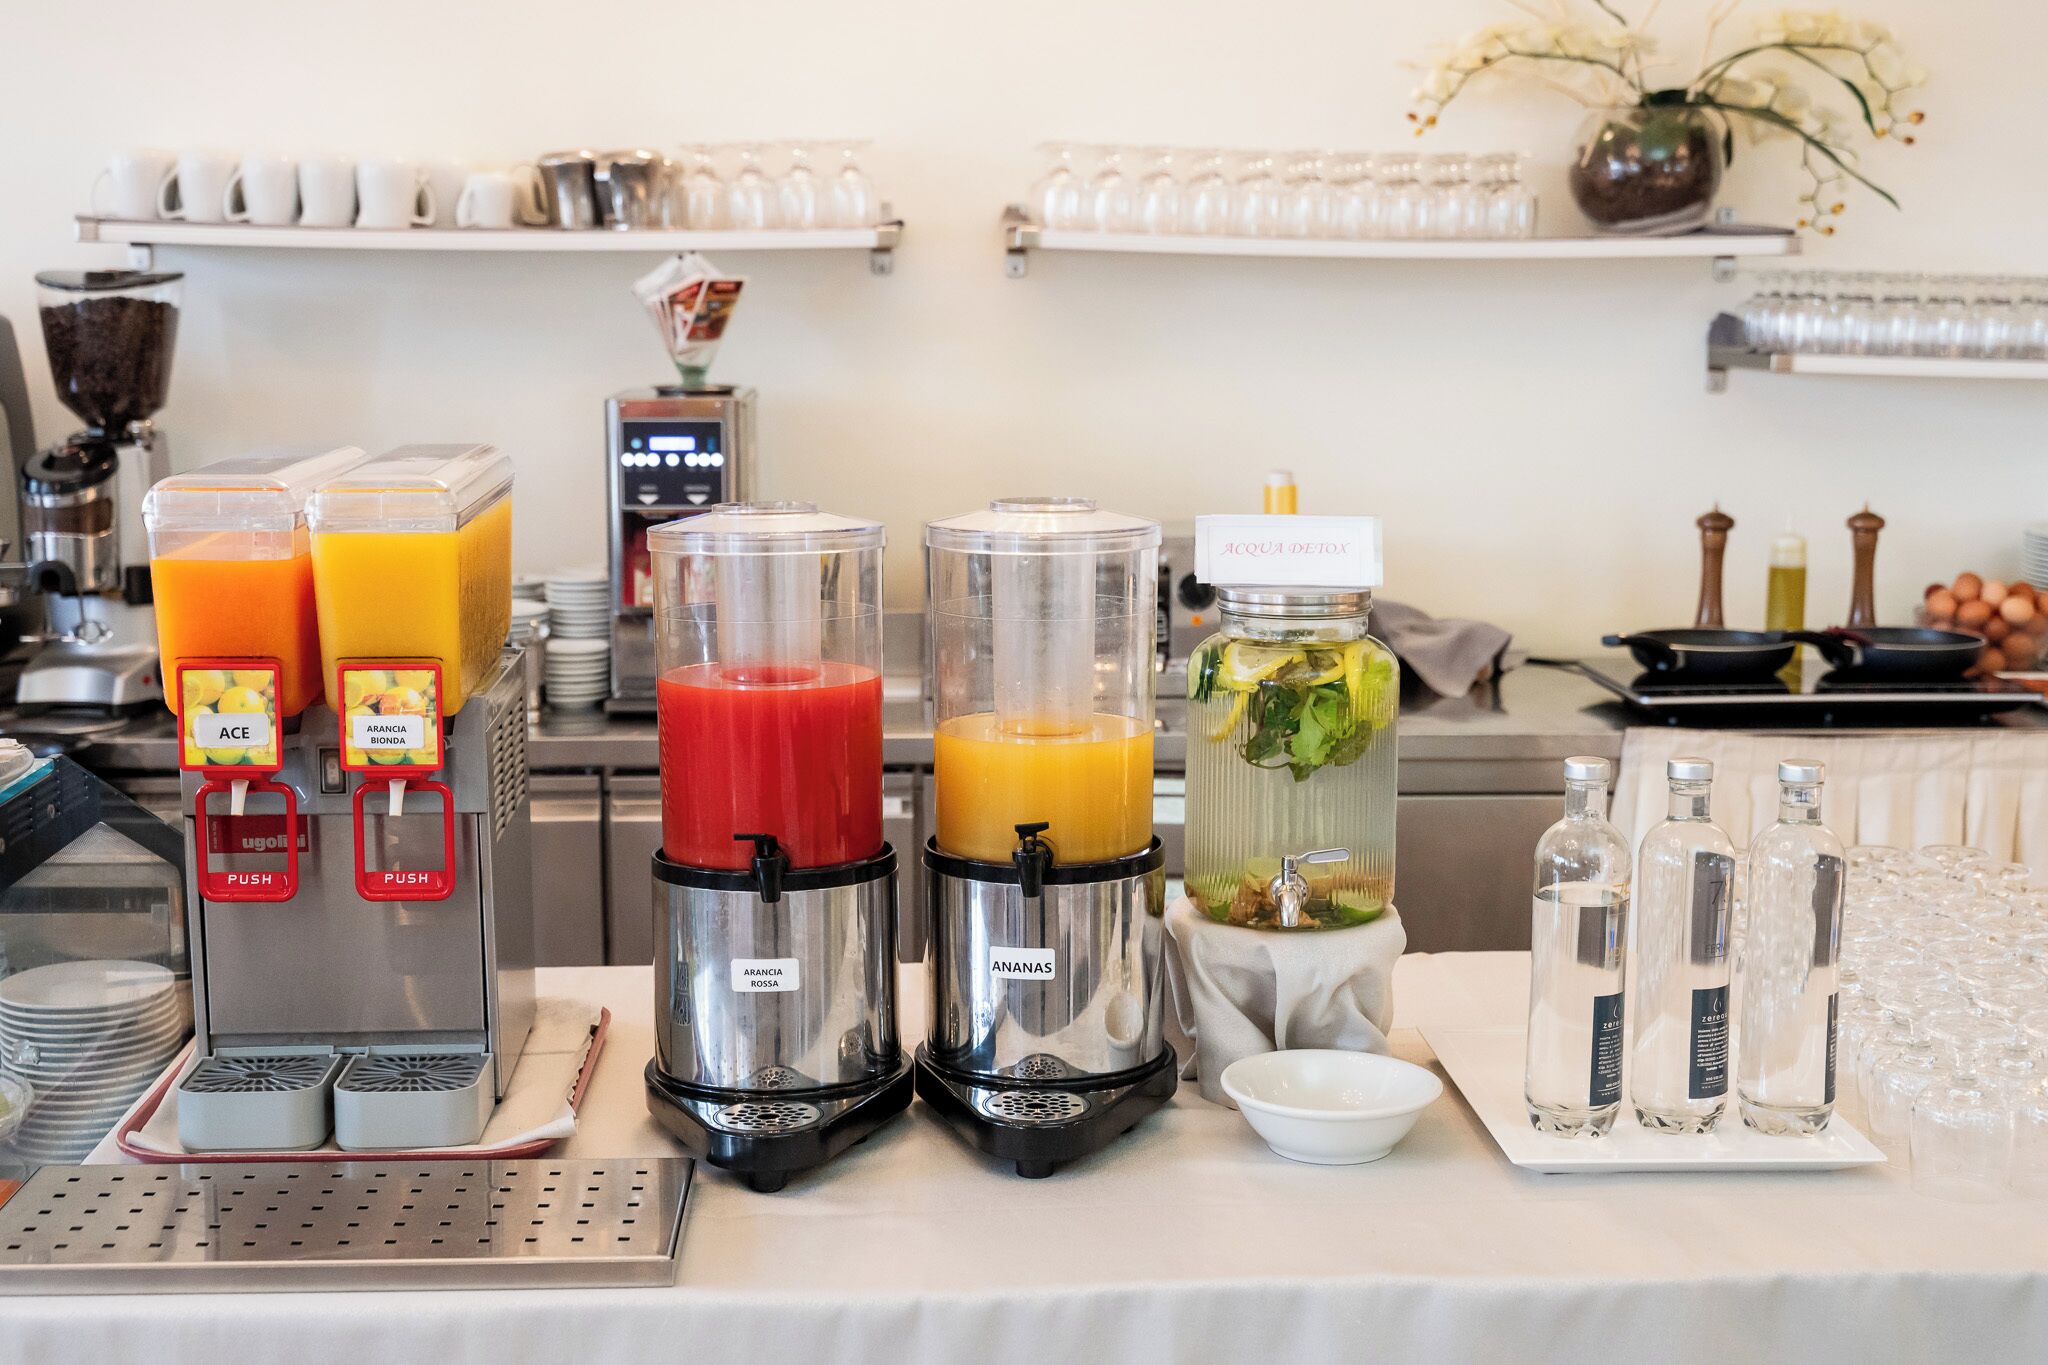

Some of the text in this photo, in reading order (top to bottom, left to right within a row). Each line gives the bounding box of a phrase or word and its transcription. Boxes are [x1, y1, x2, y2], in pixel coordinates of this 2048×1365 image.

[1220, 541, 1351, 558] ACQUA DETOX
[219, 727, 250, 739] ACE
[366, 725, 408, 734] ARANCIA
[370, 736, 407, 745] BIONDA
[242, 835, 306, 852] ugolii
[228, 875, 273, 885] PUSH
[384, 873, 429, 884] PUSH
[743, 968, 783, 977] ARANCIA
[991, 960, 1053, 975] ANANAS
[750, 980, 779, 988] ROSSA
